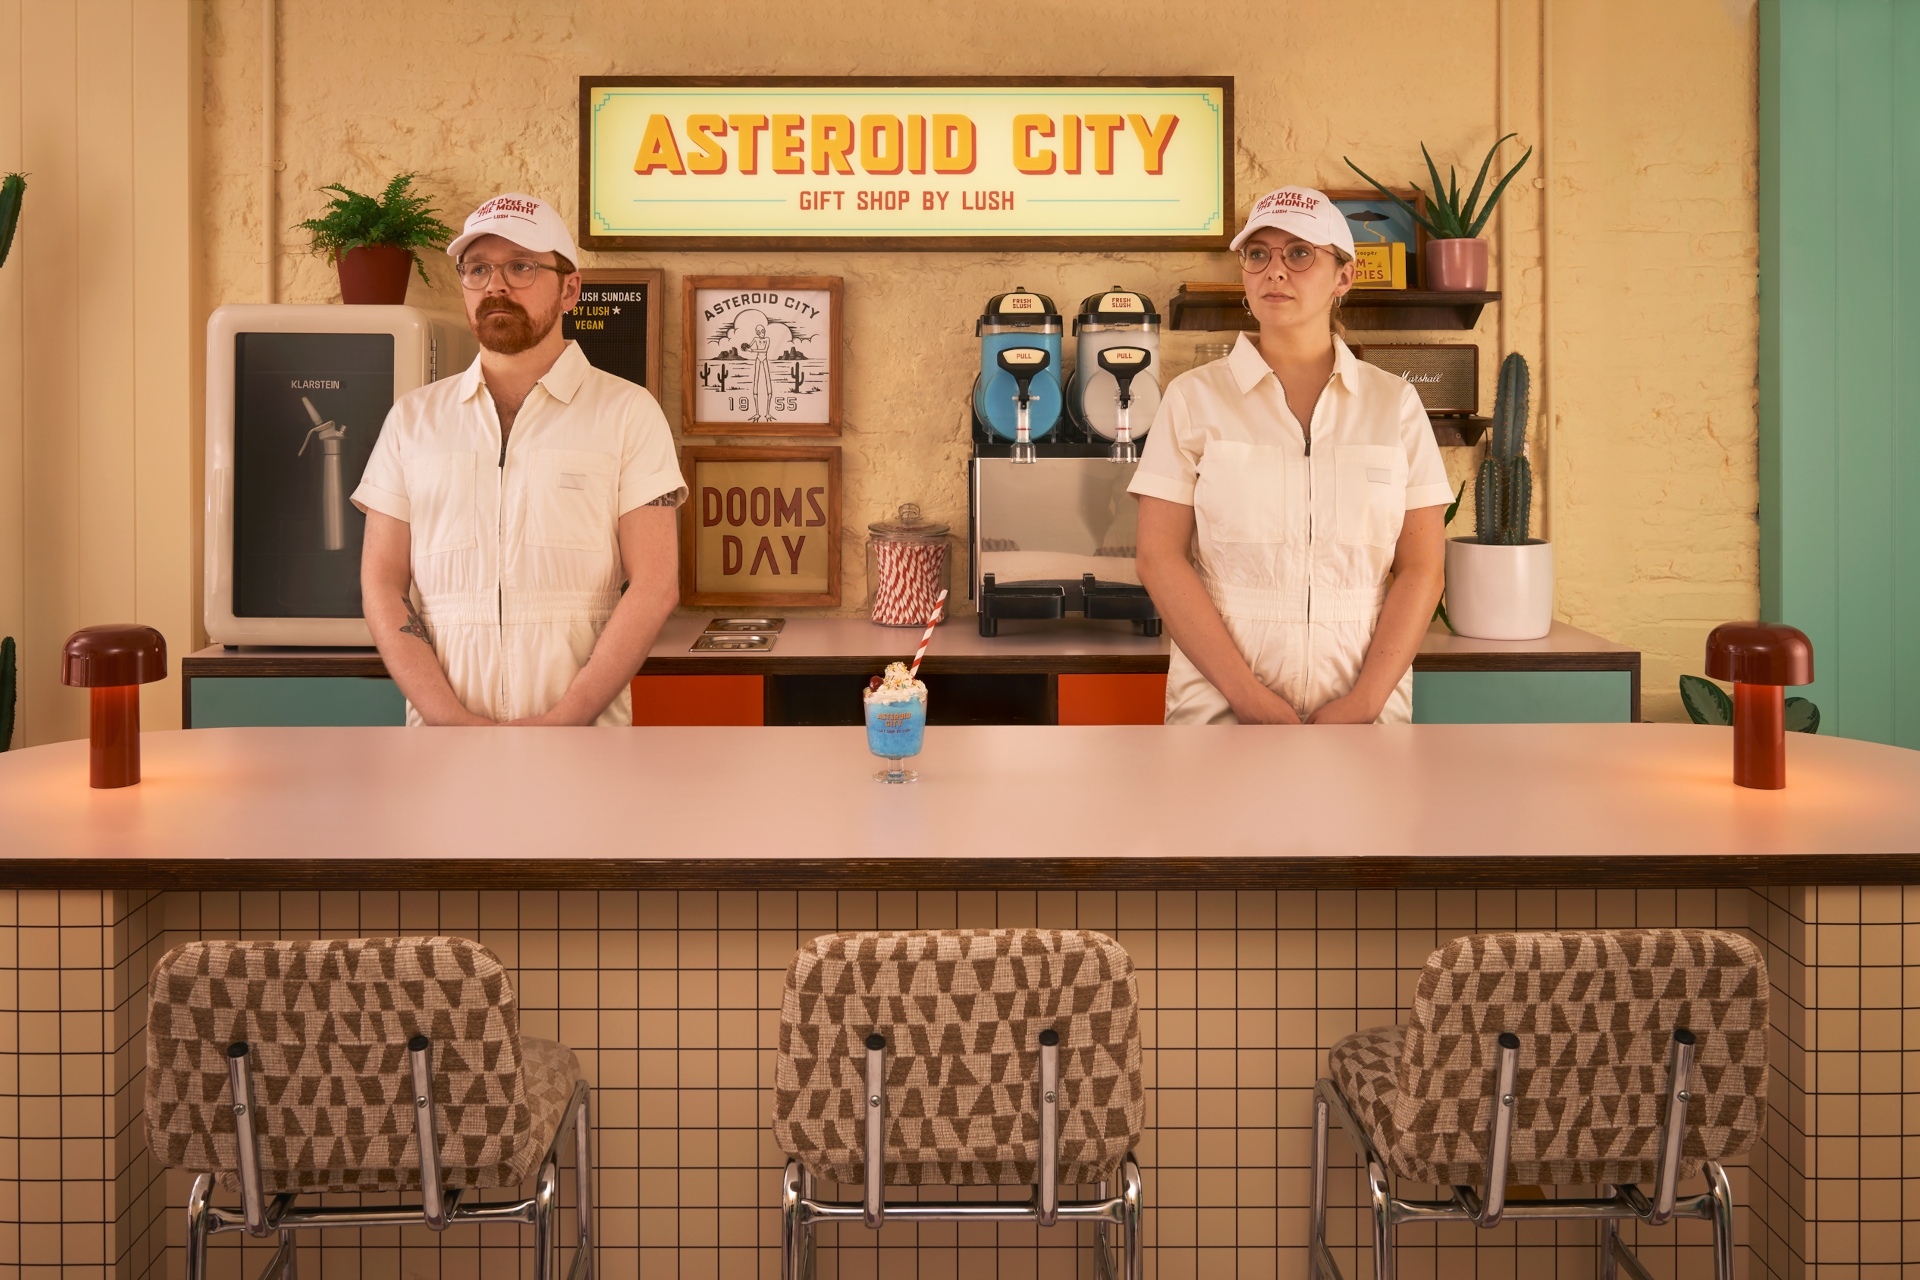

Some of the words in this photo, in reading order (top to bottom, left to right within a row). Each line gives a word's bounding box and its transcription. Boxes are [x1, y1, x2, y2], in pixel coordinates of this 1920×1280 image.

[633, 113, 977, 176] ASTEROID
[1012, 113, 1180, 176] CITY
[477, 198, 522, 214] EMPLOYEE
[526, 201, 540, 210] OF
[799, 190, 845, 210] GIFT
[857, 190, 910, 210] SHOP
[922, 190, 950, 210] BY
[962, 190, 1015, 210] LUSH
[1256, 191, 1302, 210] EMPLOYEE
[1306, 196, 1320, 206] OF
[1256, 200, 1273, 213] THE
[1275, 198, 1314, 211] MONTH
[477, 206, 493, 218] THE
[495, 203, 535, 216] MONTH
[1355, 269, 1384, 280] PIES
[601, 292, 642, 302] SUNDAES
[572, 306, 584, 316] BY
[586, 306, 610, 316] LUSH
[704, 293, 779, 322] ASTEROID
[784, 296, 820, 319] CITY
[575, 320, 604, 330] VEGAN
[1401, 370, 1443, 383] Marshall
[291, 380, 340, 389] KLARSTEIN
[702, 486, 827, 527] DOOMS
[722, 535, 806, 576] DAY
[878, 712, 911, 720] ASTEROID
